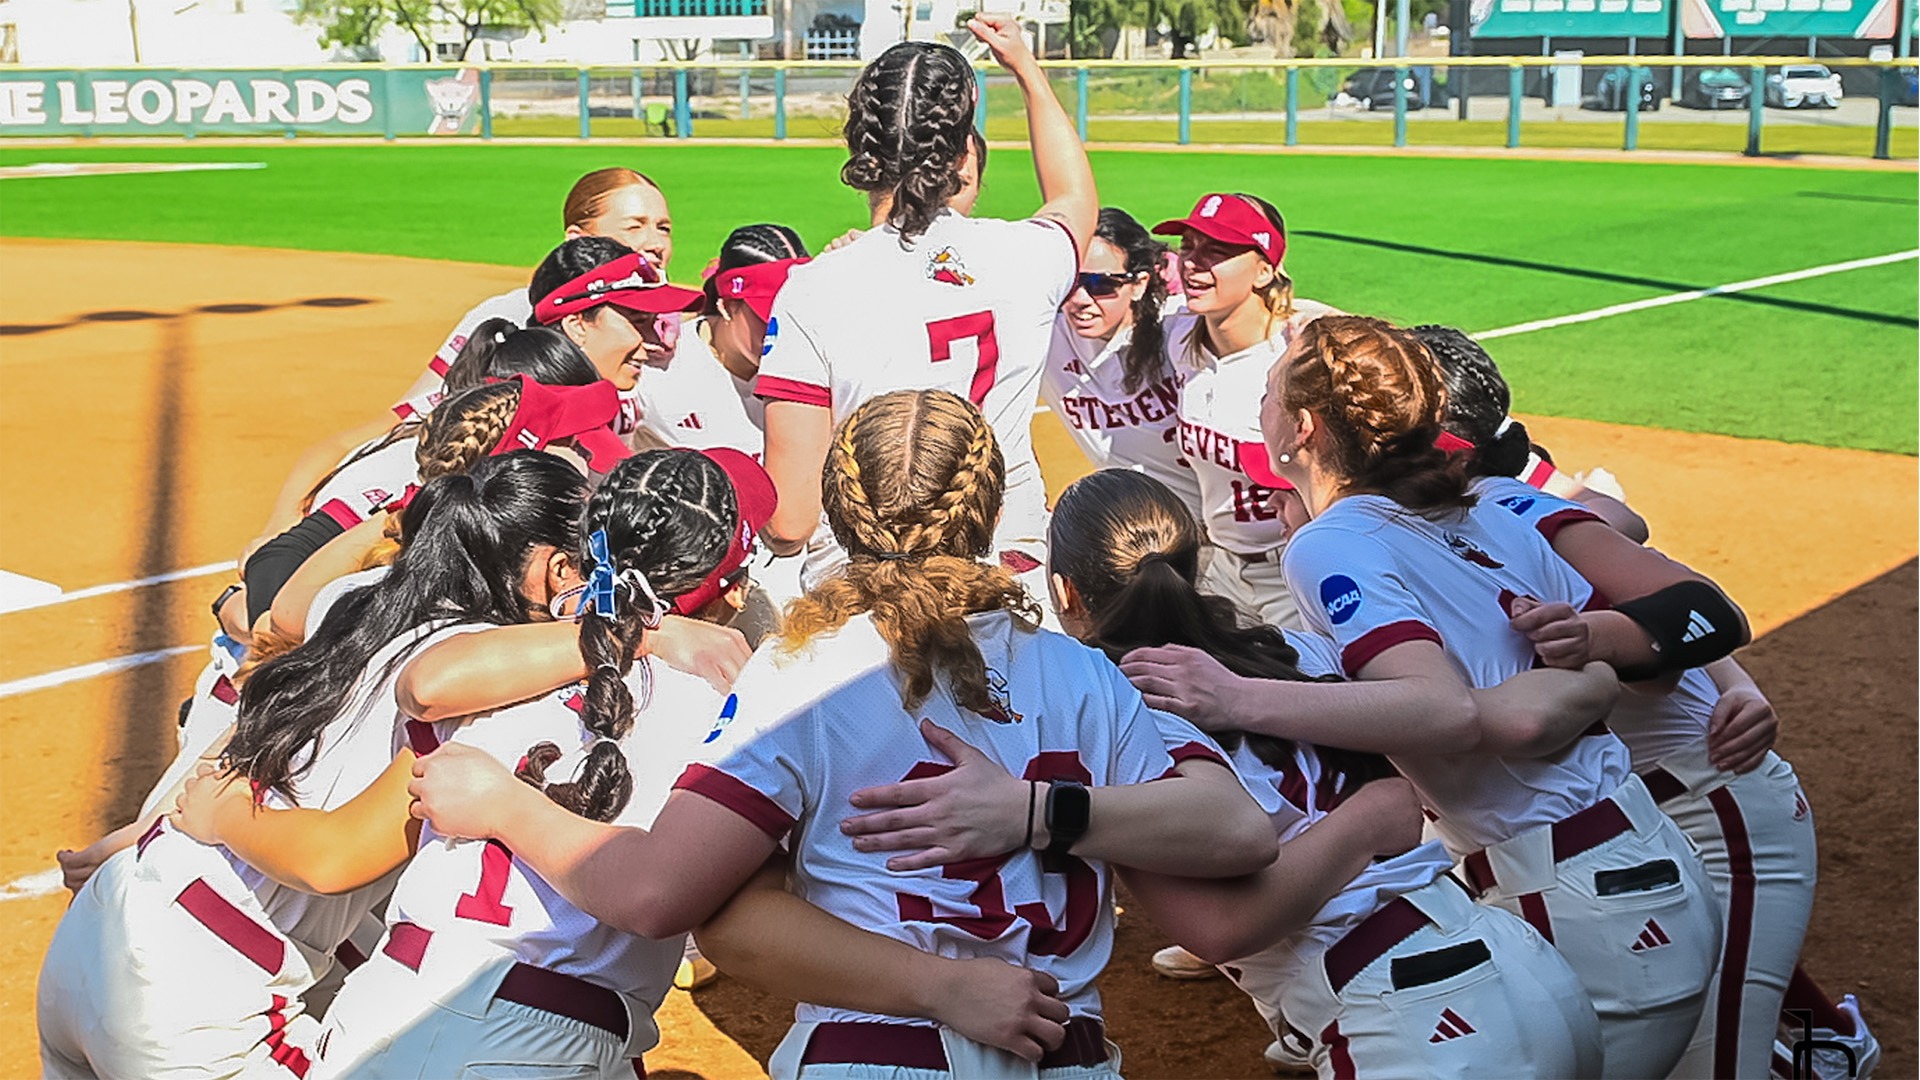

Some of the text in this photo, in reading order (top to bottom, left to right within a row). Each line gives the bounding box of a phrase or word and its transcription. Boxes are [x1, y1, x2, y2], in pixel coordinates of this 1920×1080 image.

[56, 78, 373, 125] LEOPARDS
[924, 309, 1000, 413] 7
[1326, 589, 1361, 616] NCAA
